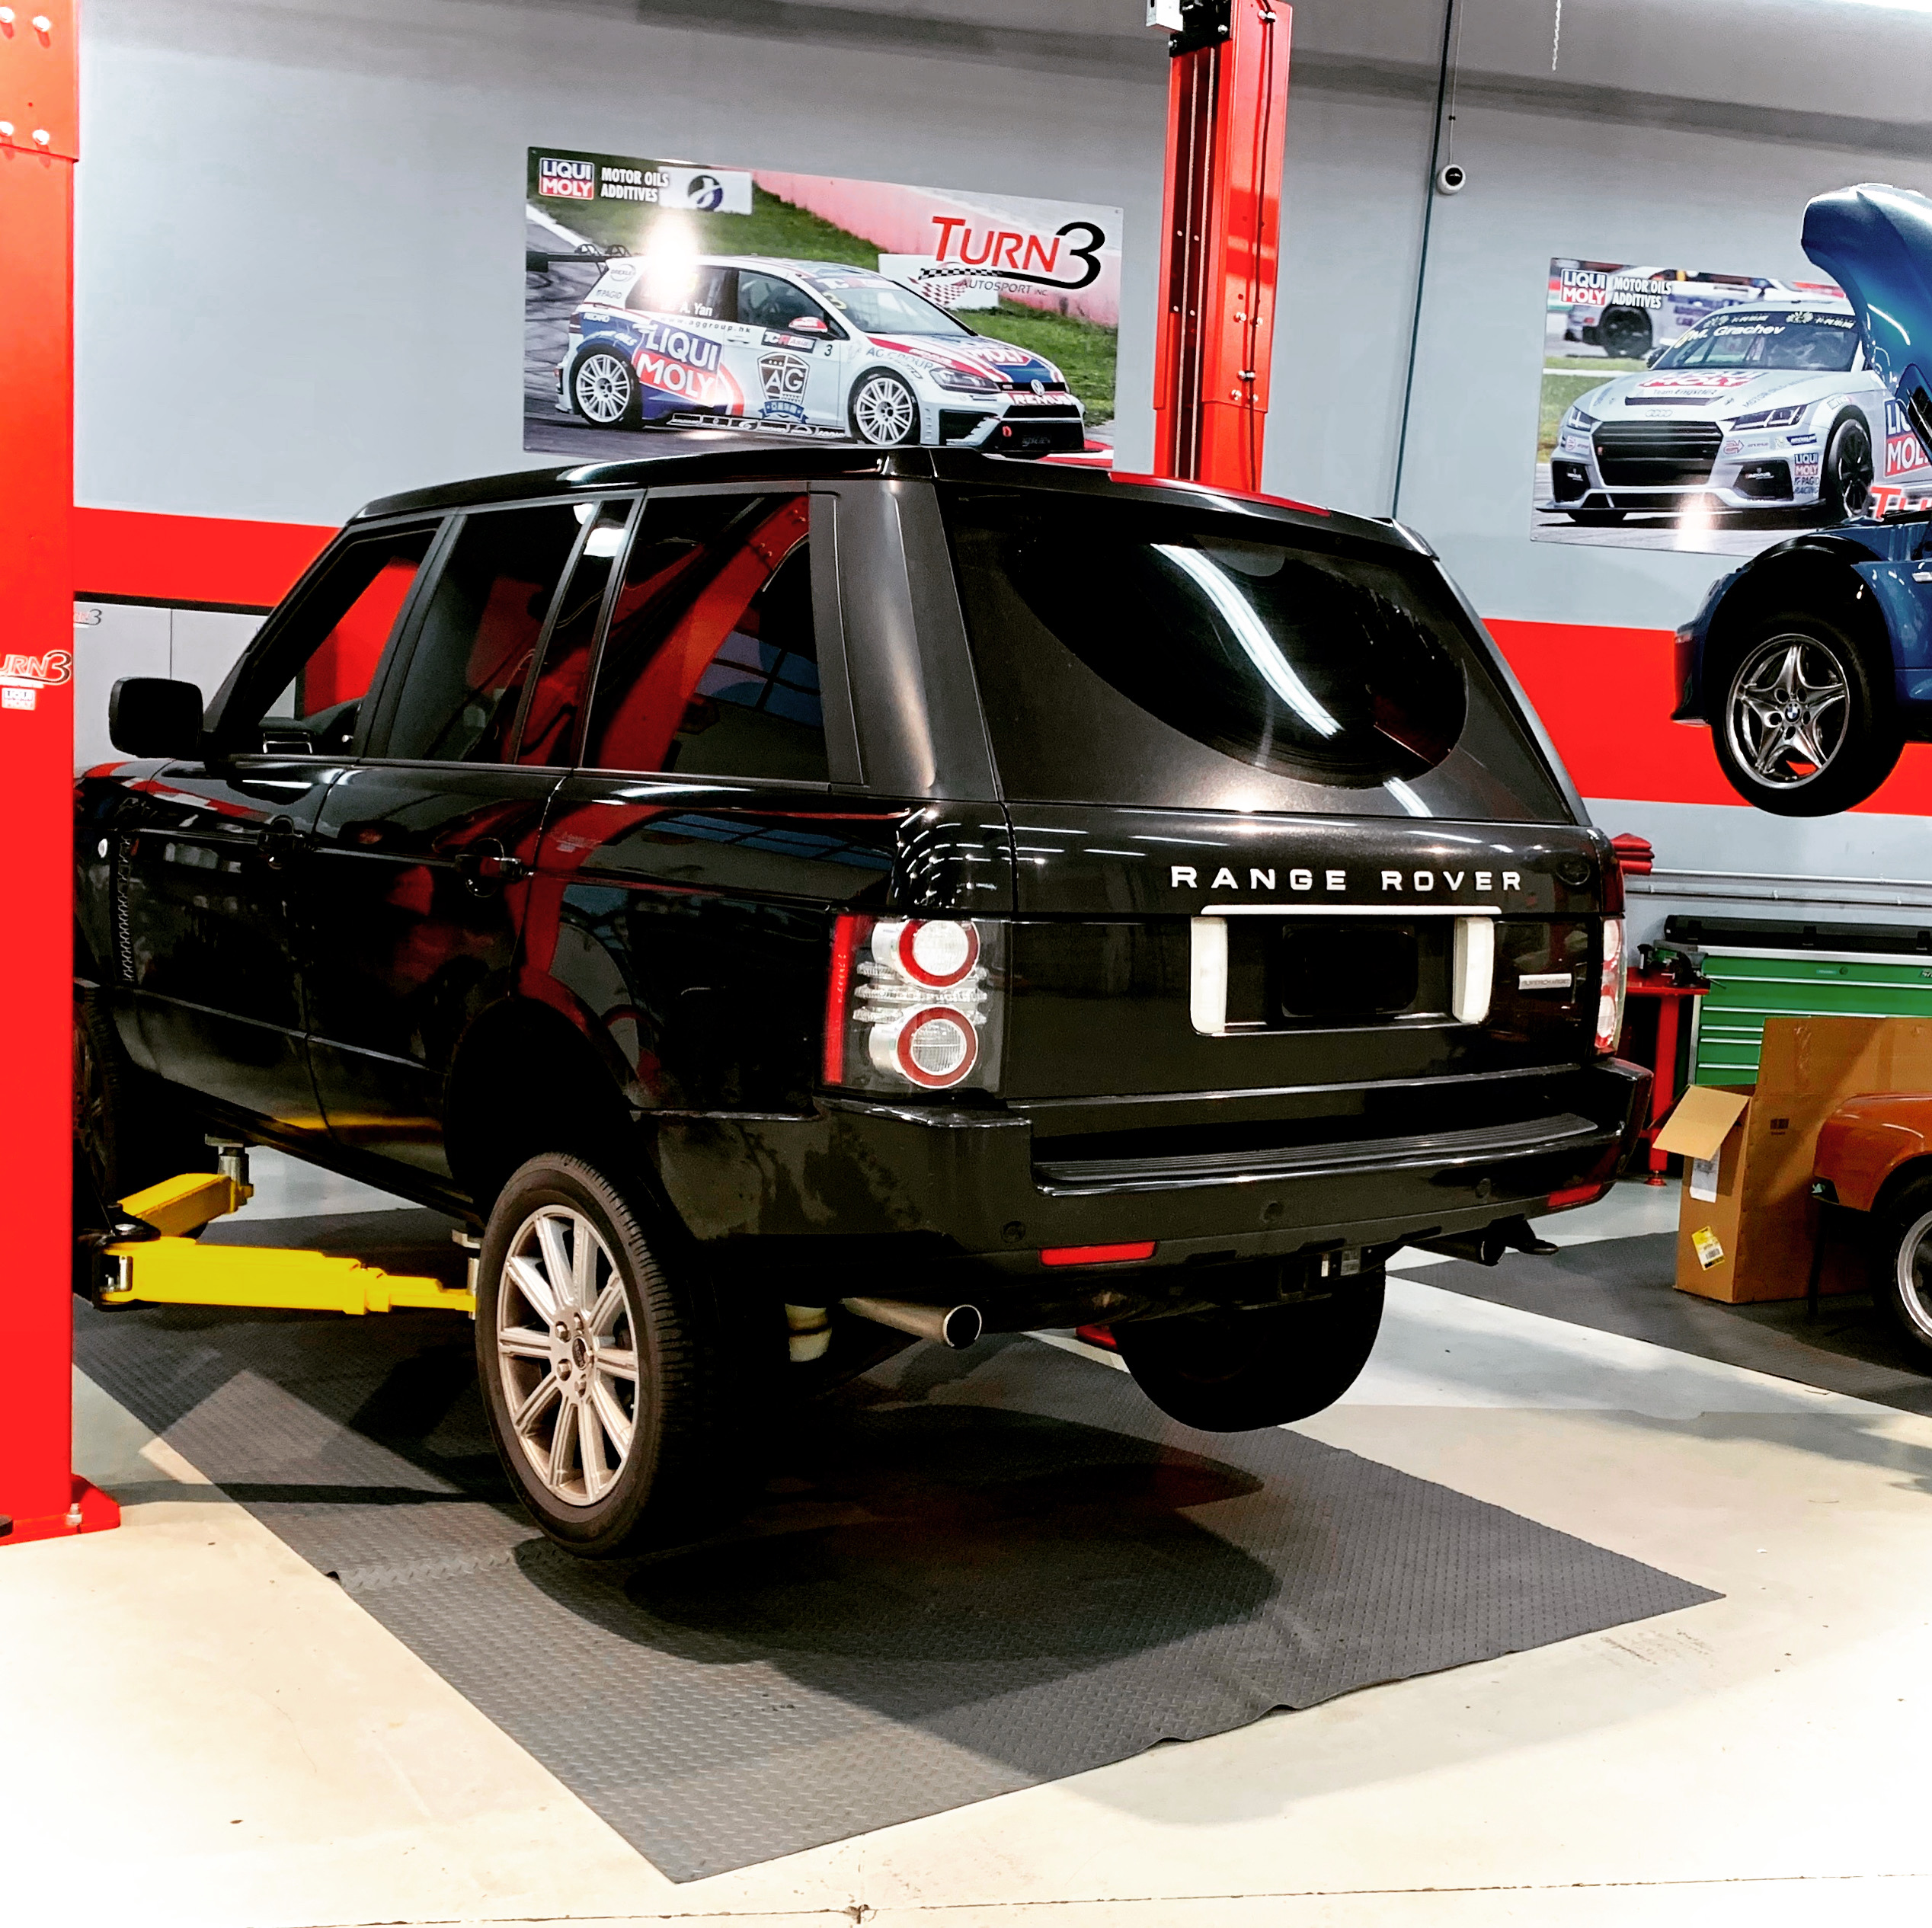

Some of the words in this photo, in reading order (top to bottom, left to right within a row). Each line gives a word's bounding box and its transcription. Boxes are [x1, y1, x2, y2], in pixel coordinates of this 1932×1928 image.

[542, 160, 591, 181] LIQUI
[601, 167, 641, 184] MOTOR
[644, 171, 669, 187] OILS
[542, 177, 592, 197] MOLY
[600, 184, 658, 203] ADDITIVES
[961, 279, 1032, 294] AUTOSPORT
[1563, 270, 1606, 289] LIQUI
[1613, 277, 1649, 293] MOTOR
[1650, 280, 1672, 296] OILS
[1562, 287, 1607, 305] MOLY
[1611, 291, 1662, 309] ADDITIVES
[694, 302, 713, 317] Yan
[645, 328, 718, 372] LIQUI
[824, 344, 833, 357] 3
[635, 353, 716, 401] MOLY
[1795, 452, 1818, 465] LIQUI
[1795, 464, 1818, 475] MOLY
[1170, 865, 1347, 892] RANGE
[1381, 870, 1521, 891] ROVER
